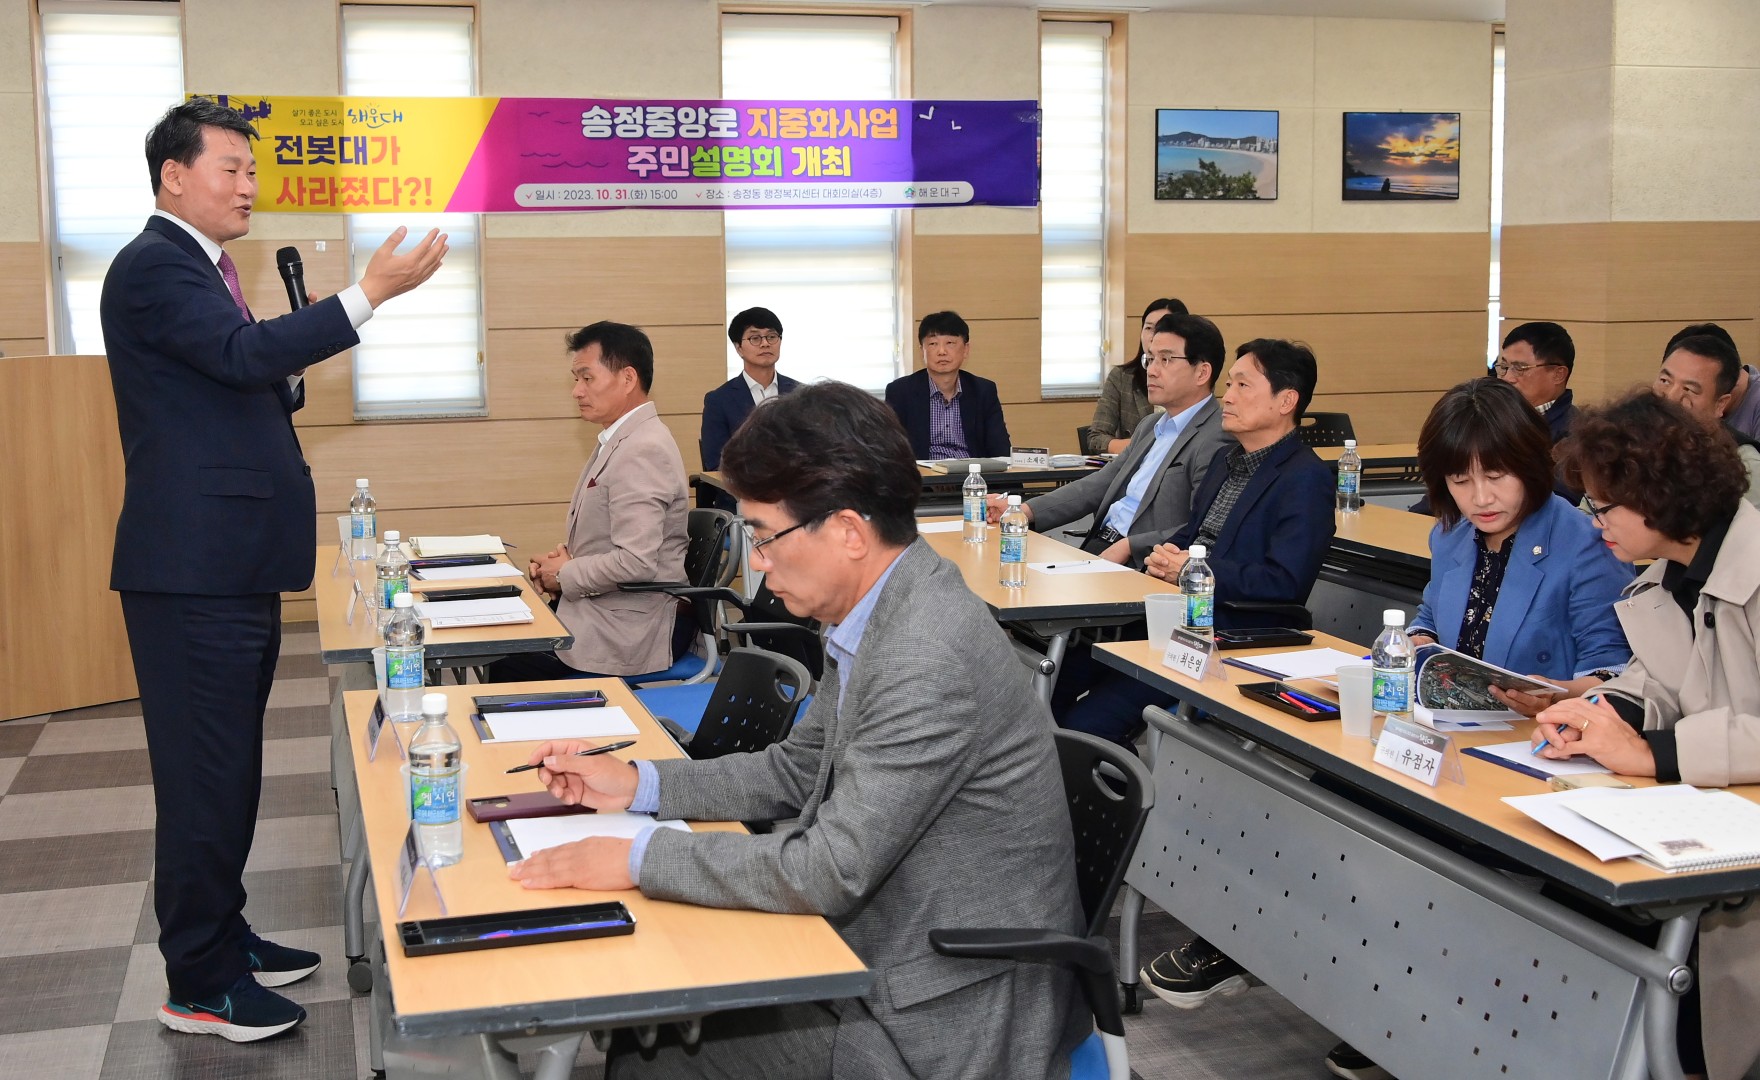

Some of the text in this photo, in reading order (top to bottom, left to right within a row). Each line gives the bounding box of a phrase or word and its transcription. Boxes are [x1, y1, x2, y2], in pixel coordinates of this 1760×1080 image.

[291, 109, 338, 118] 살기 좋은 도시
[315, 118, 329, 127] 싶은
[331, 118, 345, 127] 도시
[346, 107, 403, 129] 해운대
[580, 104, 899, 140] 송정중앙로 지중화사업
[274, 135, 401, 166] 전봇대가
[627, 145, 852, 178] 주민설명회 개최
[275, 176, 433, 207] 사라졌다?!
[535, 189, 555, 201] 일시
[563, 189, 594, 200] 2023.
[596, 189, 613, 200] 10.
[650, 189, 678, 200] 15:00
[705, 189, 725, 200] 장소
[733, 188, 762, 200] 송정동
[764, 188, 820, 199] 행정복지센터
[822, 188, 883, 199] 대회의실(4층)
[918, 187, 960, 198] 해운대구
[1180, 652, 1203, 673] 최은영
[1401, 749, 1436, 776] 유점자
